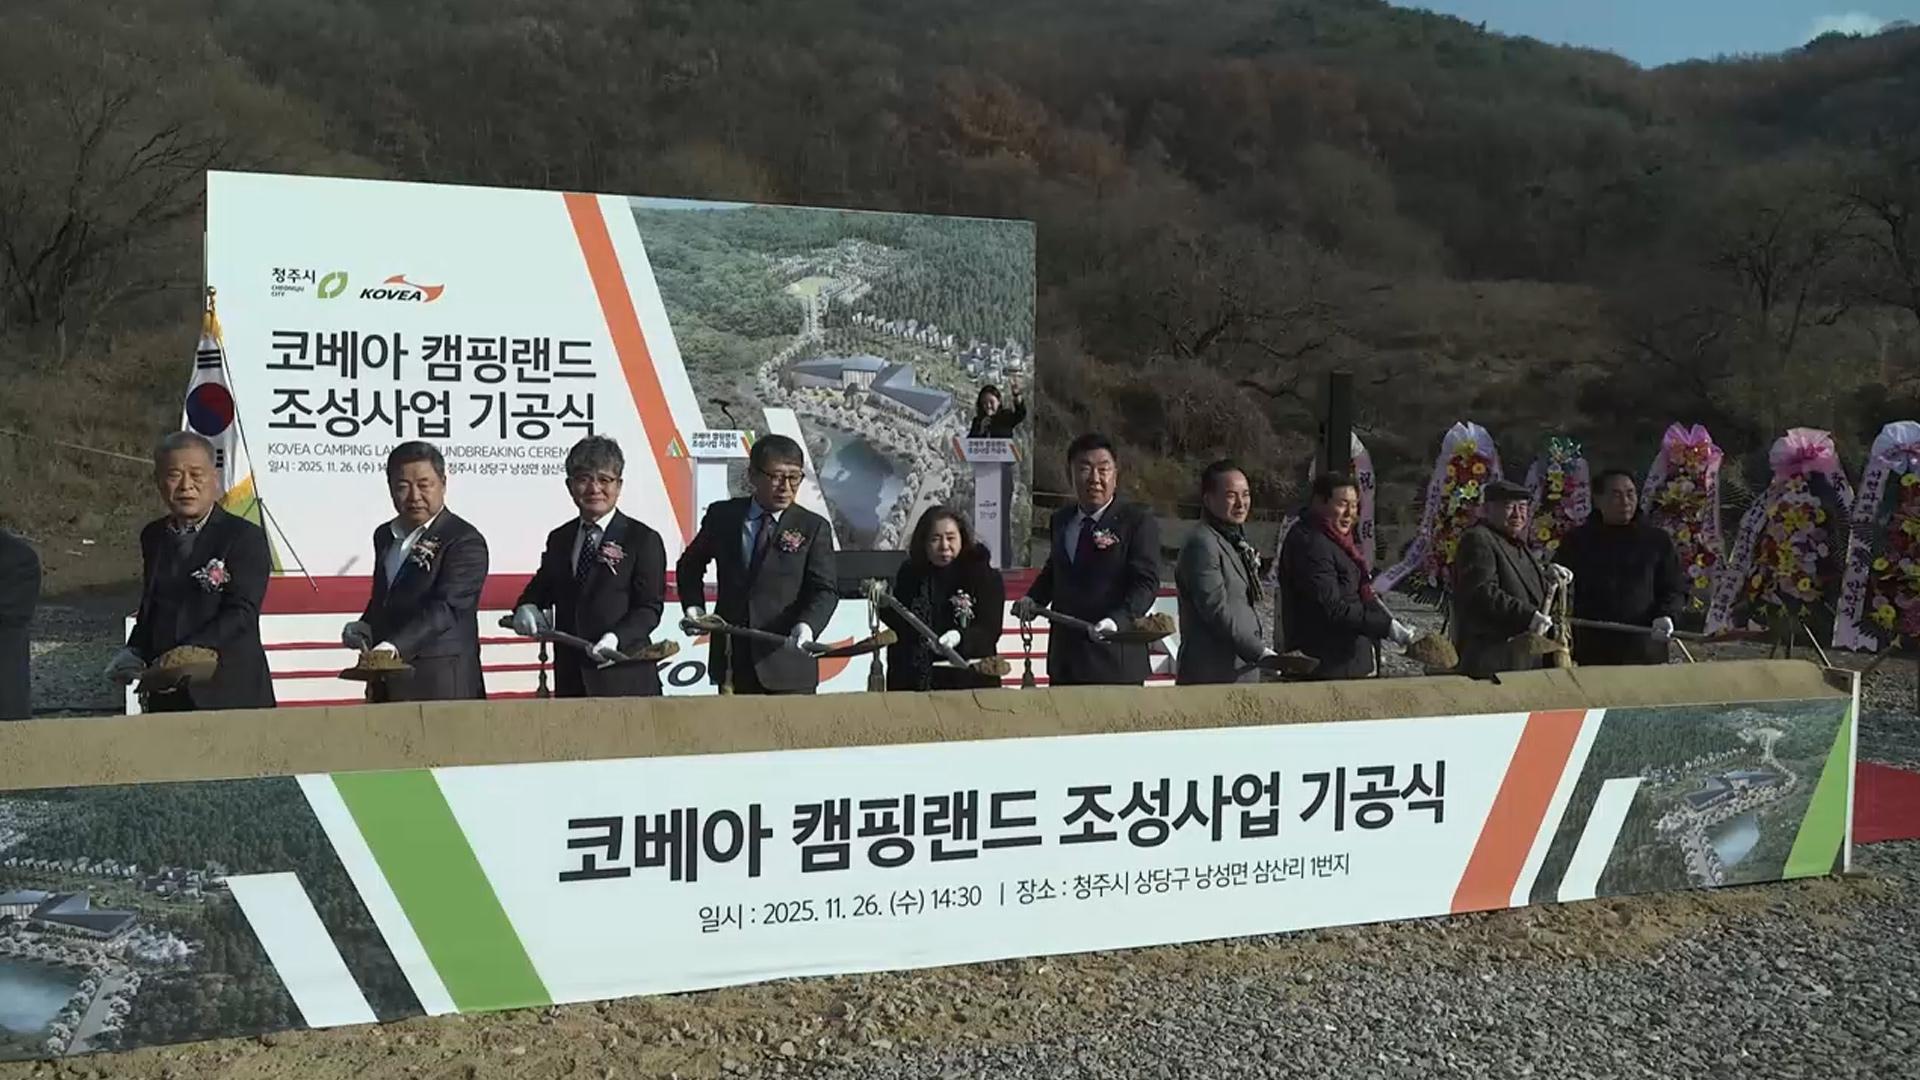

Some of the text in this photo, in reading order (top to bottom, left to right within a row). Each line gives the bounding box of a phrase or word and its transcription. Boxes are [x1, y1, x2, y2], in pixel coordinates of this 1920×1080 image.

[272, 267, 316, 284] 청주시
[360, 288, 421, 301] KOVEA
[266, 331, 597, 383] 코베아 캠핑랜드
[268, 388, 594, 440] 조성사업 기공식
[268, 443, 311, 454] KOVEA
[314, 444, 372, 456] CAMPING
[268, 460, 289, 472] 일시
[298, 461, 324, 472] 2025.
[340, 462, 354, 472] 26.
[357, 462, 375, 473] (수)
[558, 761, 1446, 882] 코베아 캠핑랜드 조성사업 기공식
[699, 904, 742, 933] 일시
[763, 900, 819, 925] 2025.
[826, 898, 846, 919] 11.
[853, 894, 882, 916] 26.
[890, 889, 925, 916] (수)
[931, 885, 982, 909] 14:30
[1016, 879, 1057, 905] 장소
[1073, 871, 1129, 900] 청주시
[1134, 867, 1190, 894] 상당구
[1195, 861, 1248, 889] 낭성면
[1252, 856, 1305, 884] 삼산리
[1310, 852, 1350, 877] 1번지
